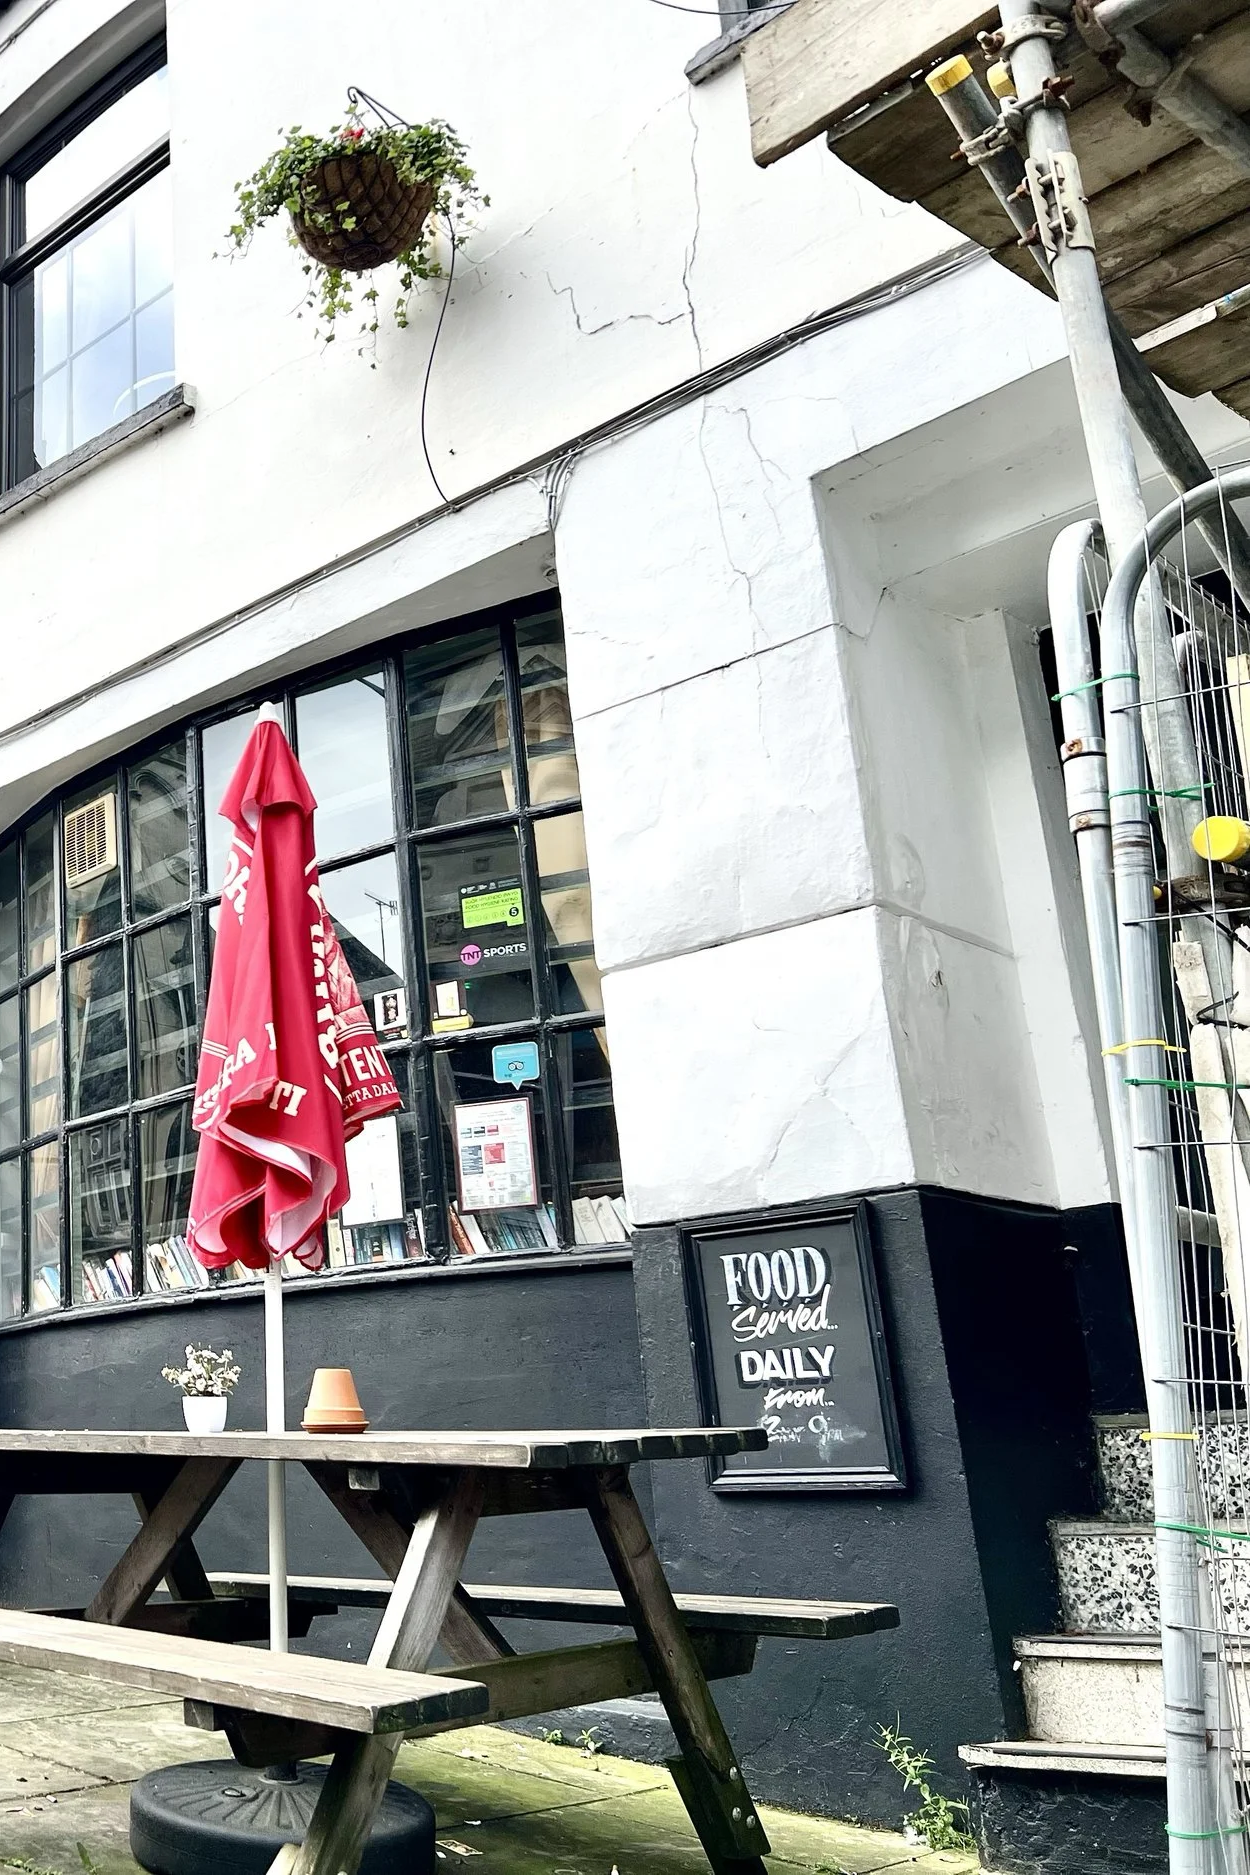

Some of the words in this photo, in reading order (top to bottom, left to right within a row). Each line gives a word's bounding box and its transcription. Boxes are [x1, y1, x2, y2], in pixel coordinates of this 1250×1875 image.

[461, 950, 482, 962] TNT
[483, 942, 527, 957] SPORTS
[719, 1246, 828, 1307] FOOD
[738, 1345, 836, 1384] DAILY
